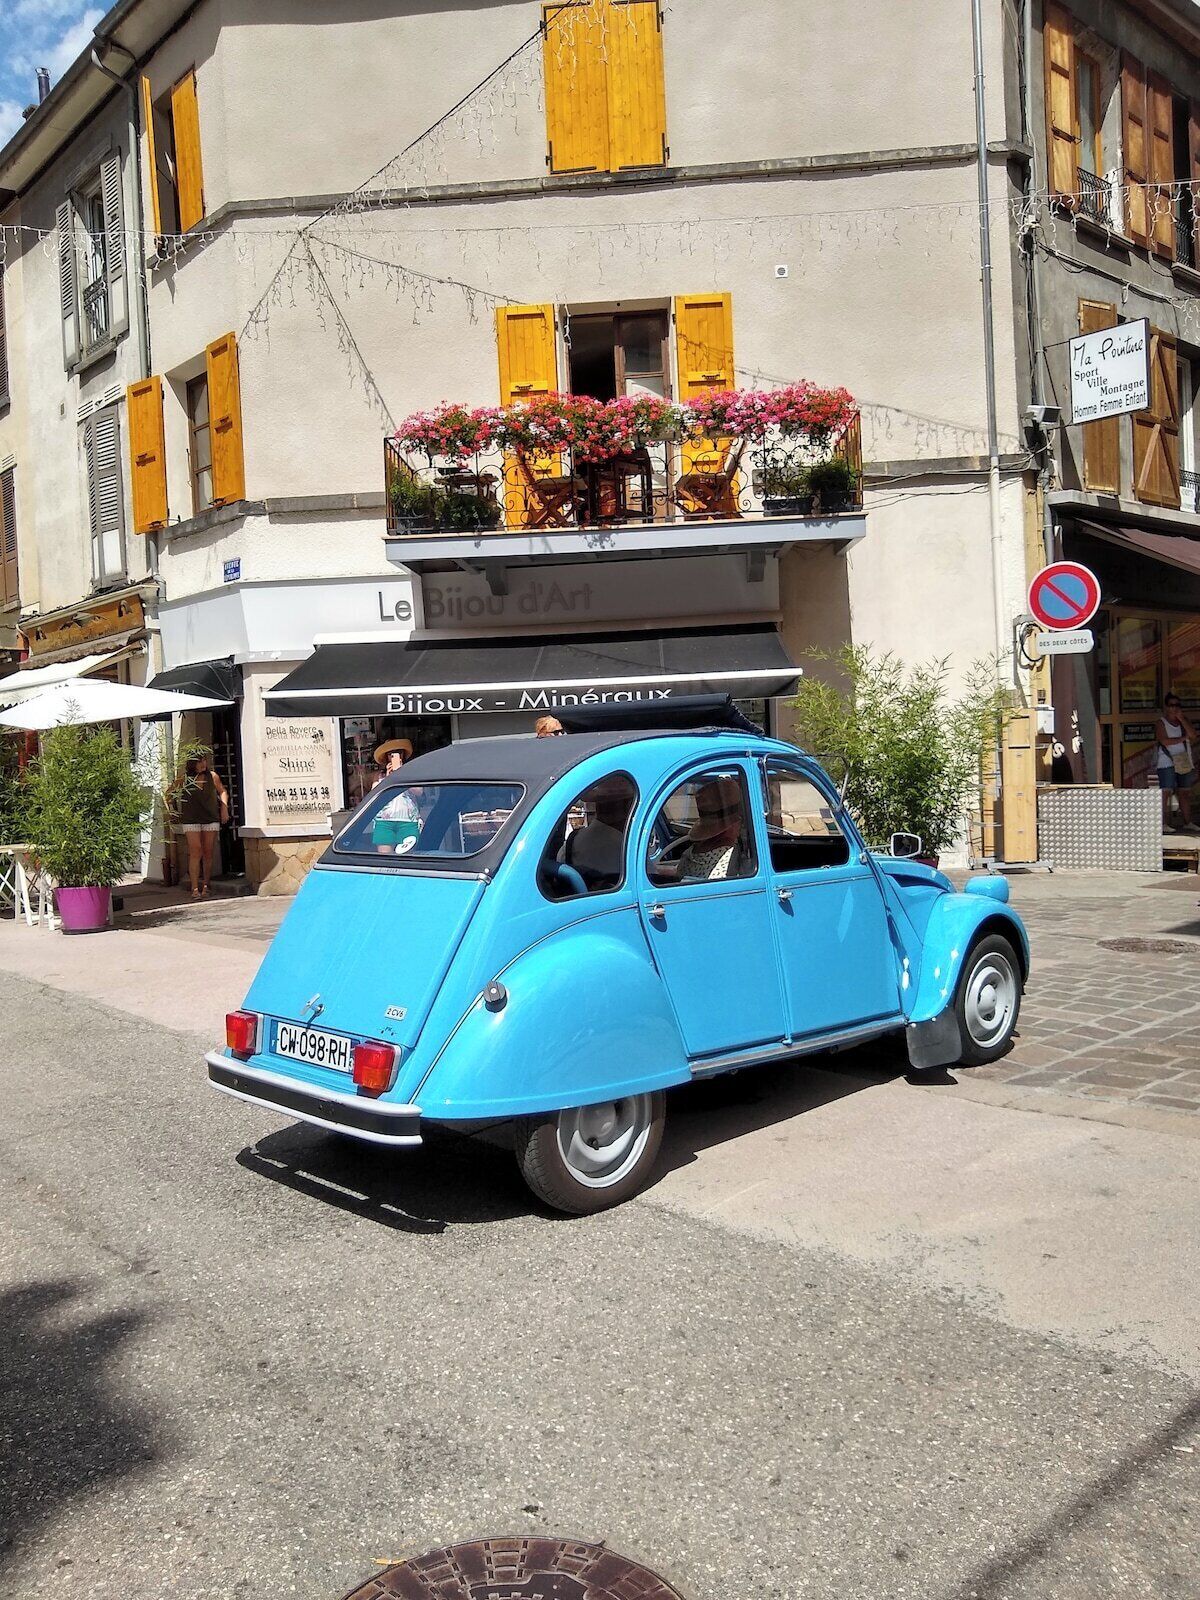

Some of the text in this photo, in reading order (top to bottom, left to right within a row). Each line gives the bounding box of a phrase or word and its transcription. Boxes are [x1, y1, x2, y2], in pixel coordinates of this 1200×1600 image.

[1073, 335, 1144, 367] Ma Pointure
[1074, 367, 1099, 381] Sport
[1087, 376, 1108, 388] Ville
[1100, 379, 1145, 396] Montagne
[1073, 390, 1147, 418] Homme Femme Enfant
[378, 581, 593, 622] Le Bijou d'Art
[386, 694, 484, 713] Bijoux
[518, 688, 673, 709] Minéraux
[265, 726, 317, 736] Della Rovere
[279, 758, 316, 768] Shiné
[299, 787, 307, 796] 12
